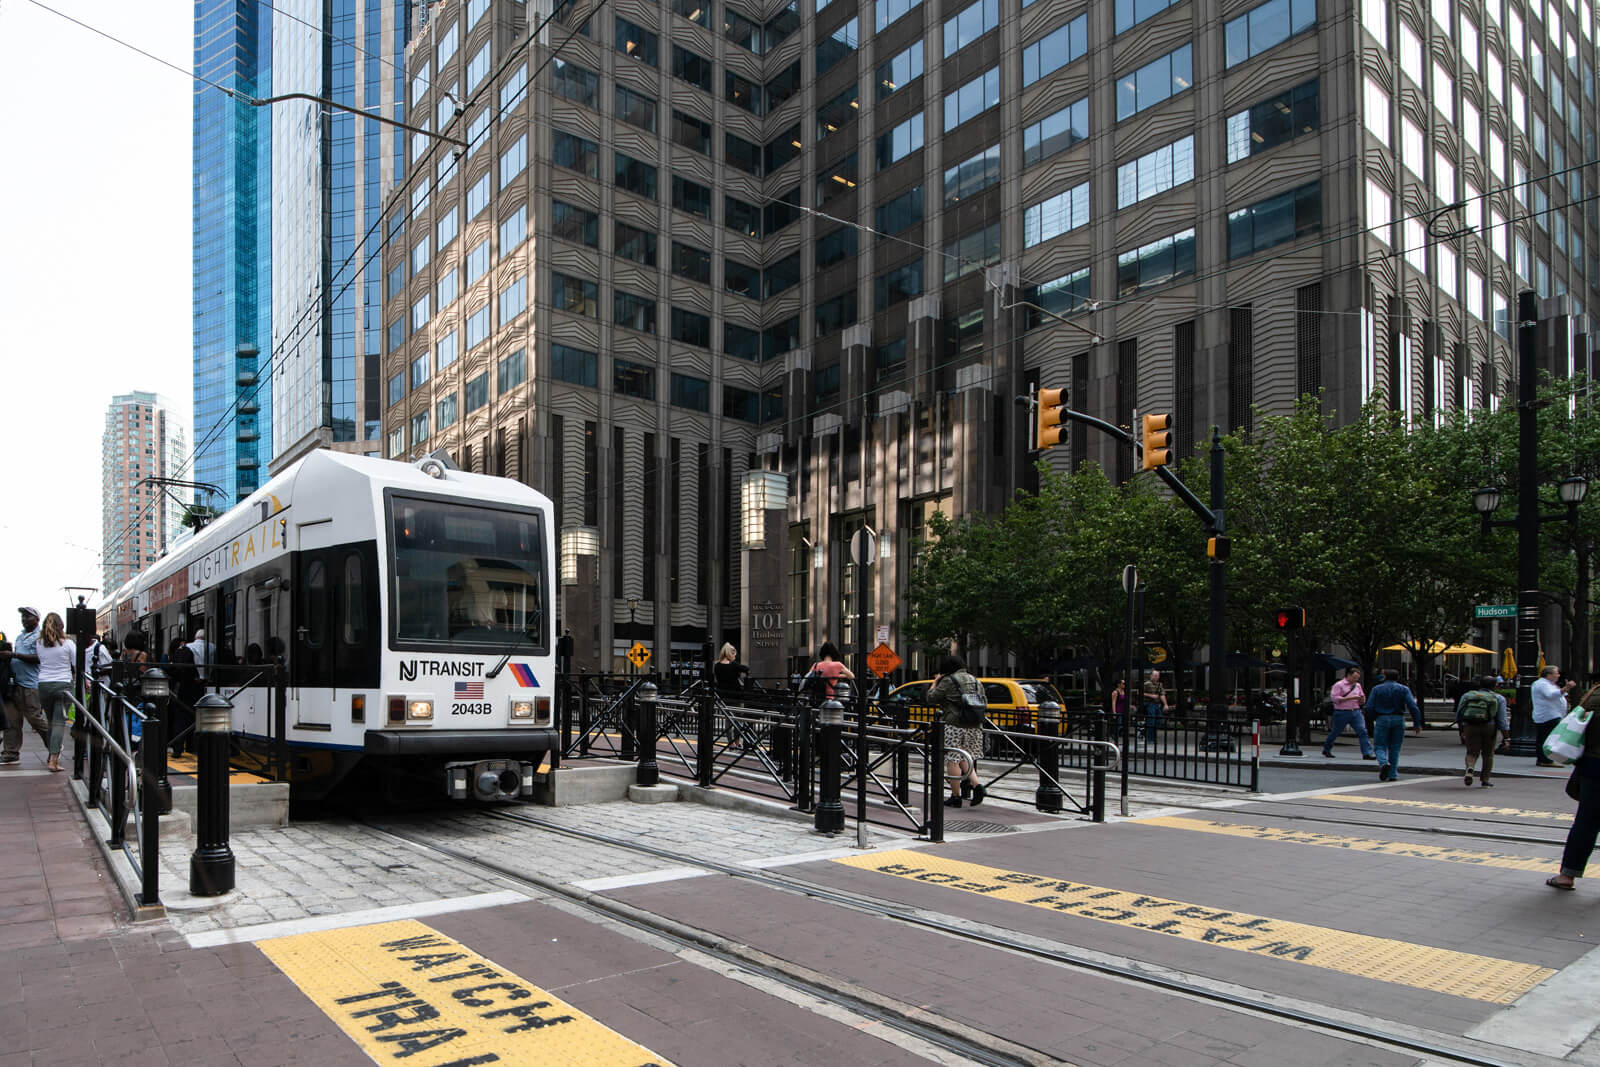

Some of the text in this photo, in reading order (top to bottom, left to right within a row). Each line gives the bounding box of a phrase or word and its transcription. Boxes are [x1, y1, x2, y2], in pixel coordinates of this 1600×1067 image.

[752, 613, 783, 630] 101
[1477, 607, 1508, 616] Hudson
[400, 660, 485, 681] NJ TRANSIT
[451, 703, 492, 716] 2043B
[877, 864, 1314, 960] WATCH FOR
[994, 873, 1273, 932] TRAINS
[379, 934, 576, 1034] WATCH
